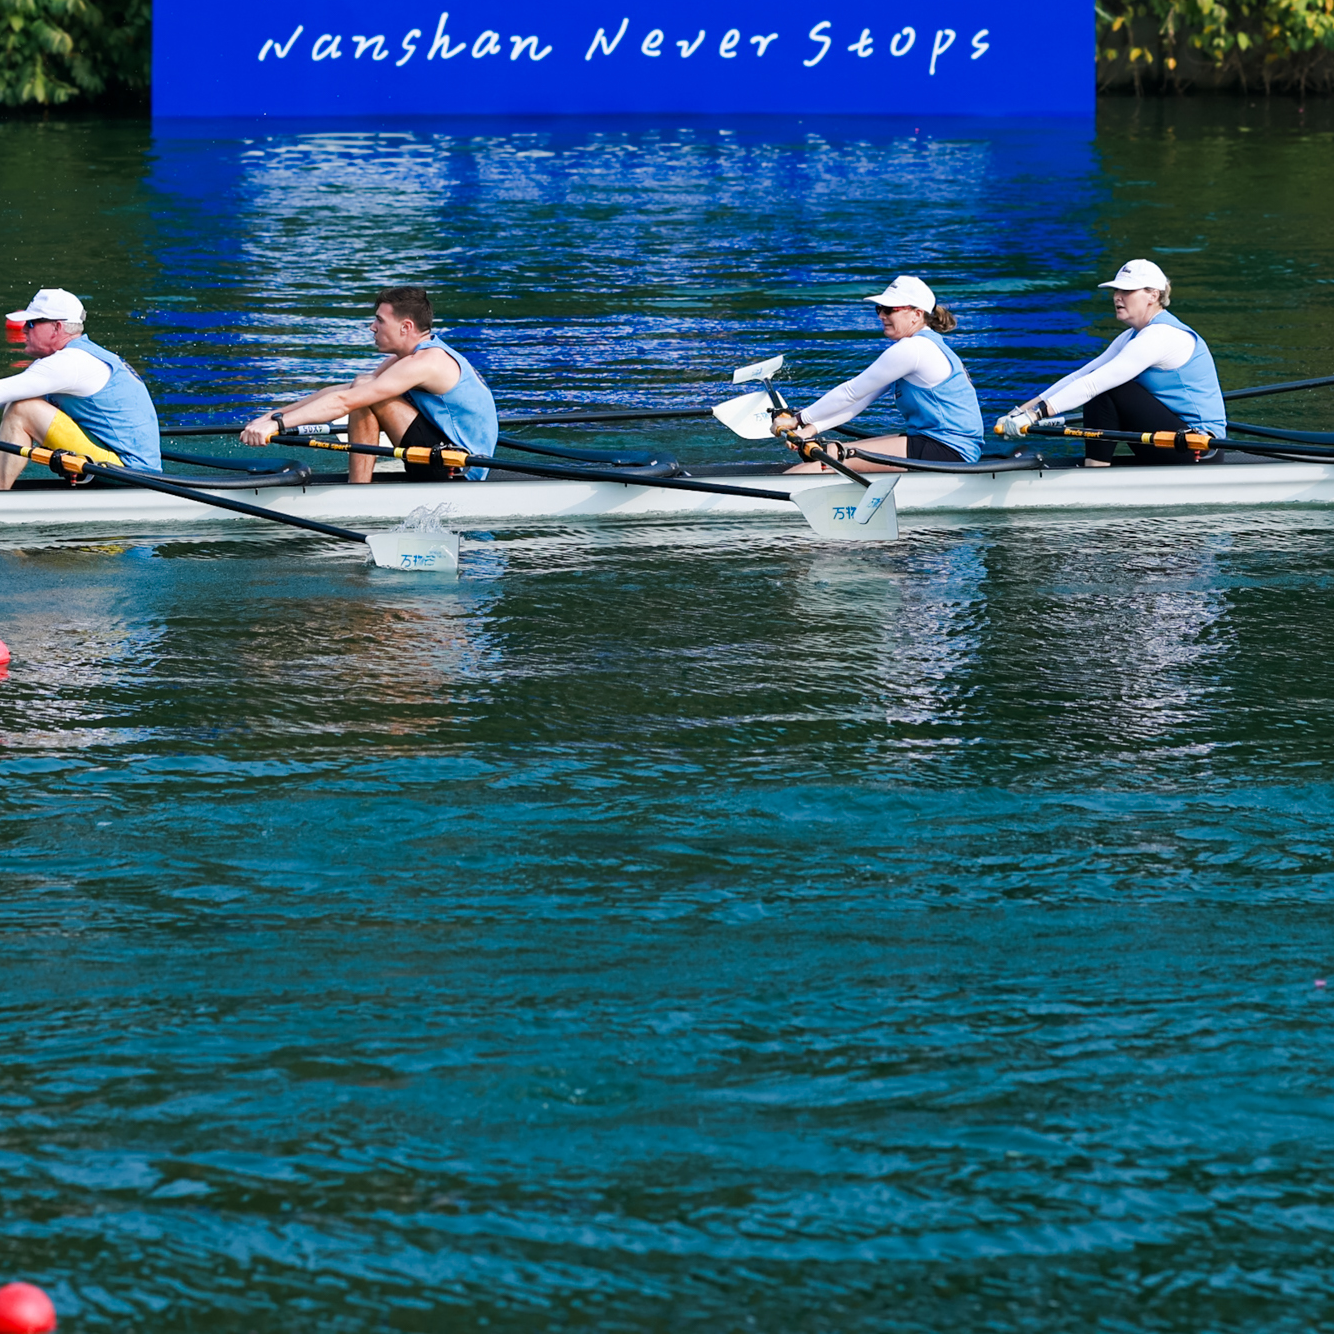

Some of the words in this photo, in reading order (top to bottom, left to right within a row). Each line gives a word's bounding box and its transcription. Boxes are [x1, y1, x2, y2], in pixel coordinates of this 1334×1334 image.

[258, 12, 552, 67] Nanshan
[585, 18, 778, 60] Never
[803, 21, 990, 75] Stops
